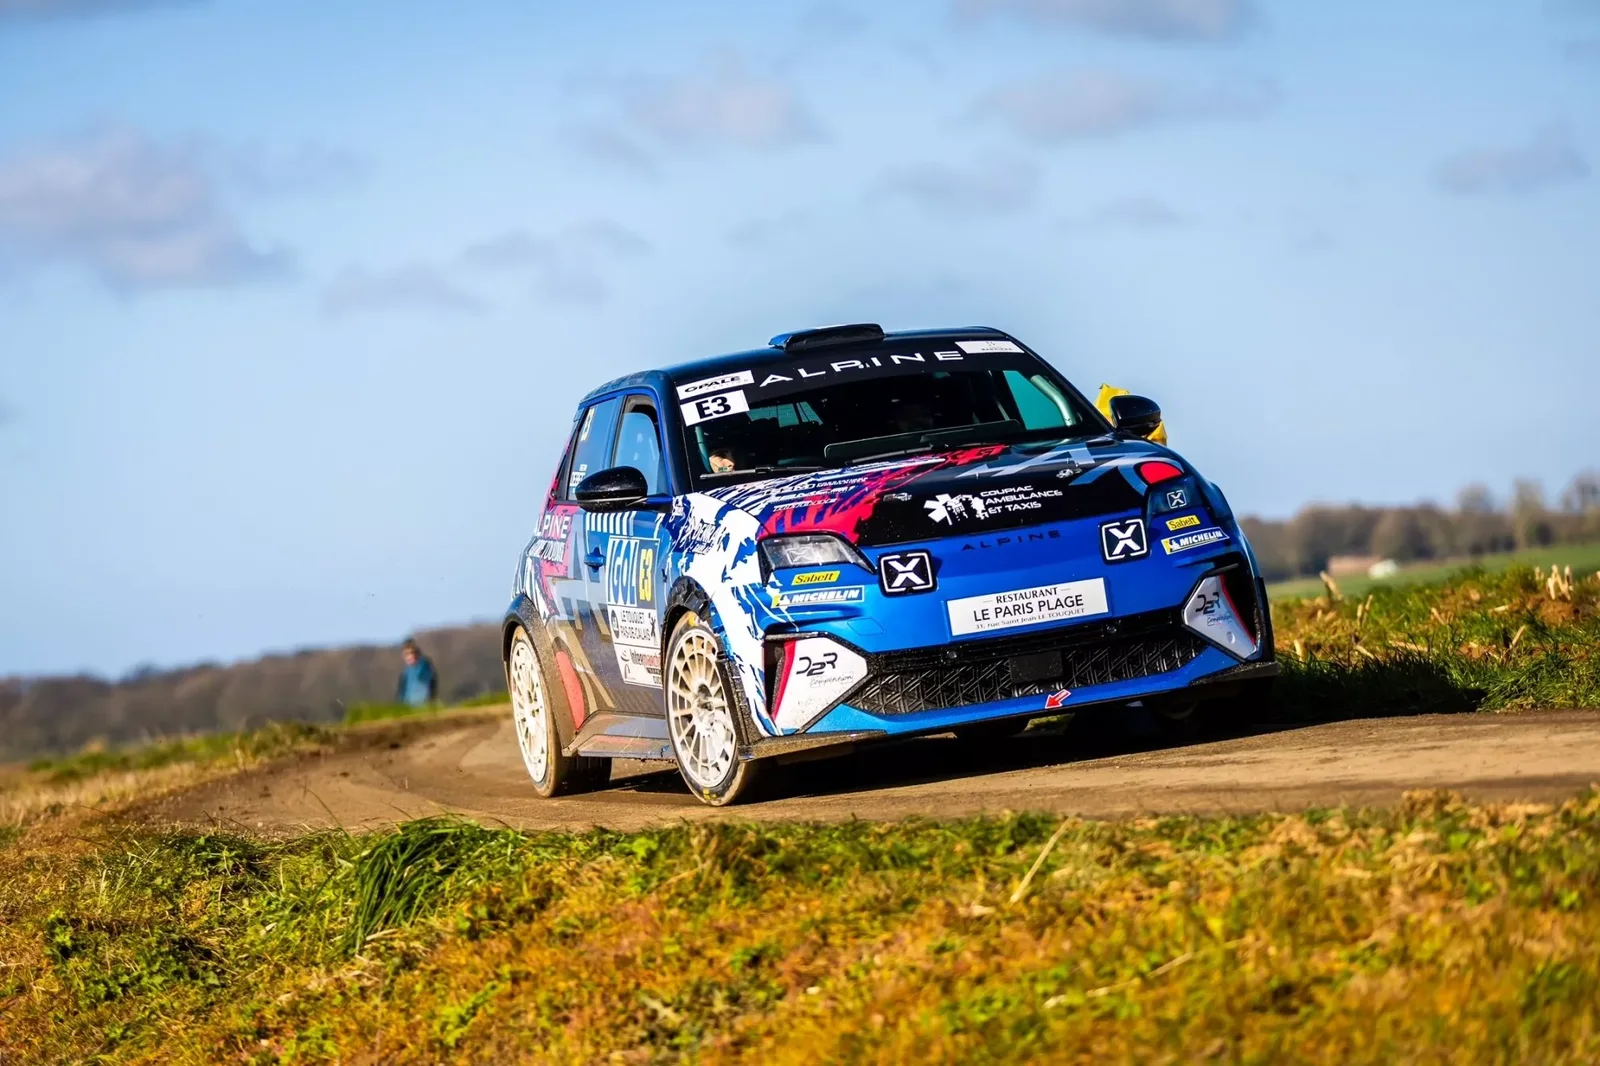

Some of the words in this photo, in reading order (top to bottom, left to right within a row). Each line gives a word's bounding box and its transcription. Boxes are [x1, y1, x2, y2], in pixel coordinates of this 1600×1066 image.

[759, 350, 964, 387] ALPINE
[684, 376, 740, 393] OPALE
[695, 396, 732, 419] E3
[980, 485, 1033, 497] COUPIAC
[985, 490, 1063, 506] AMBULANCE
[988, 505, 1003, 515] ET
[1004, 501, 1042, 513] TAXIS
[1168, 516, 1197, 529] Sabelt
[961, 529, 1061, 551] ALPINE
[1179, 531, 1223, 547] MICHELIN
[639, 548, 653, 601] E3
[794, 572, 835, 585] Sabelt
[791, 588, 860, 603] MICHELIN
[996, 586, 1058, 604] RESTAURANT
[973, 609, 990, 622] LE
[994, 602, 1034, 619] PARIS
[1038, 594, 1084, 612] PLAGE
[796, 652, 838, 677] D2R
